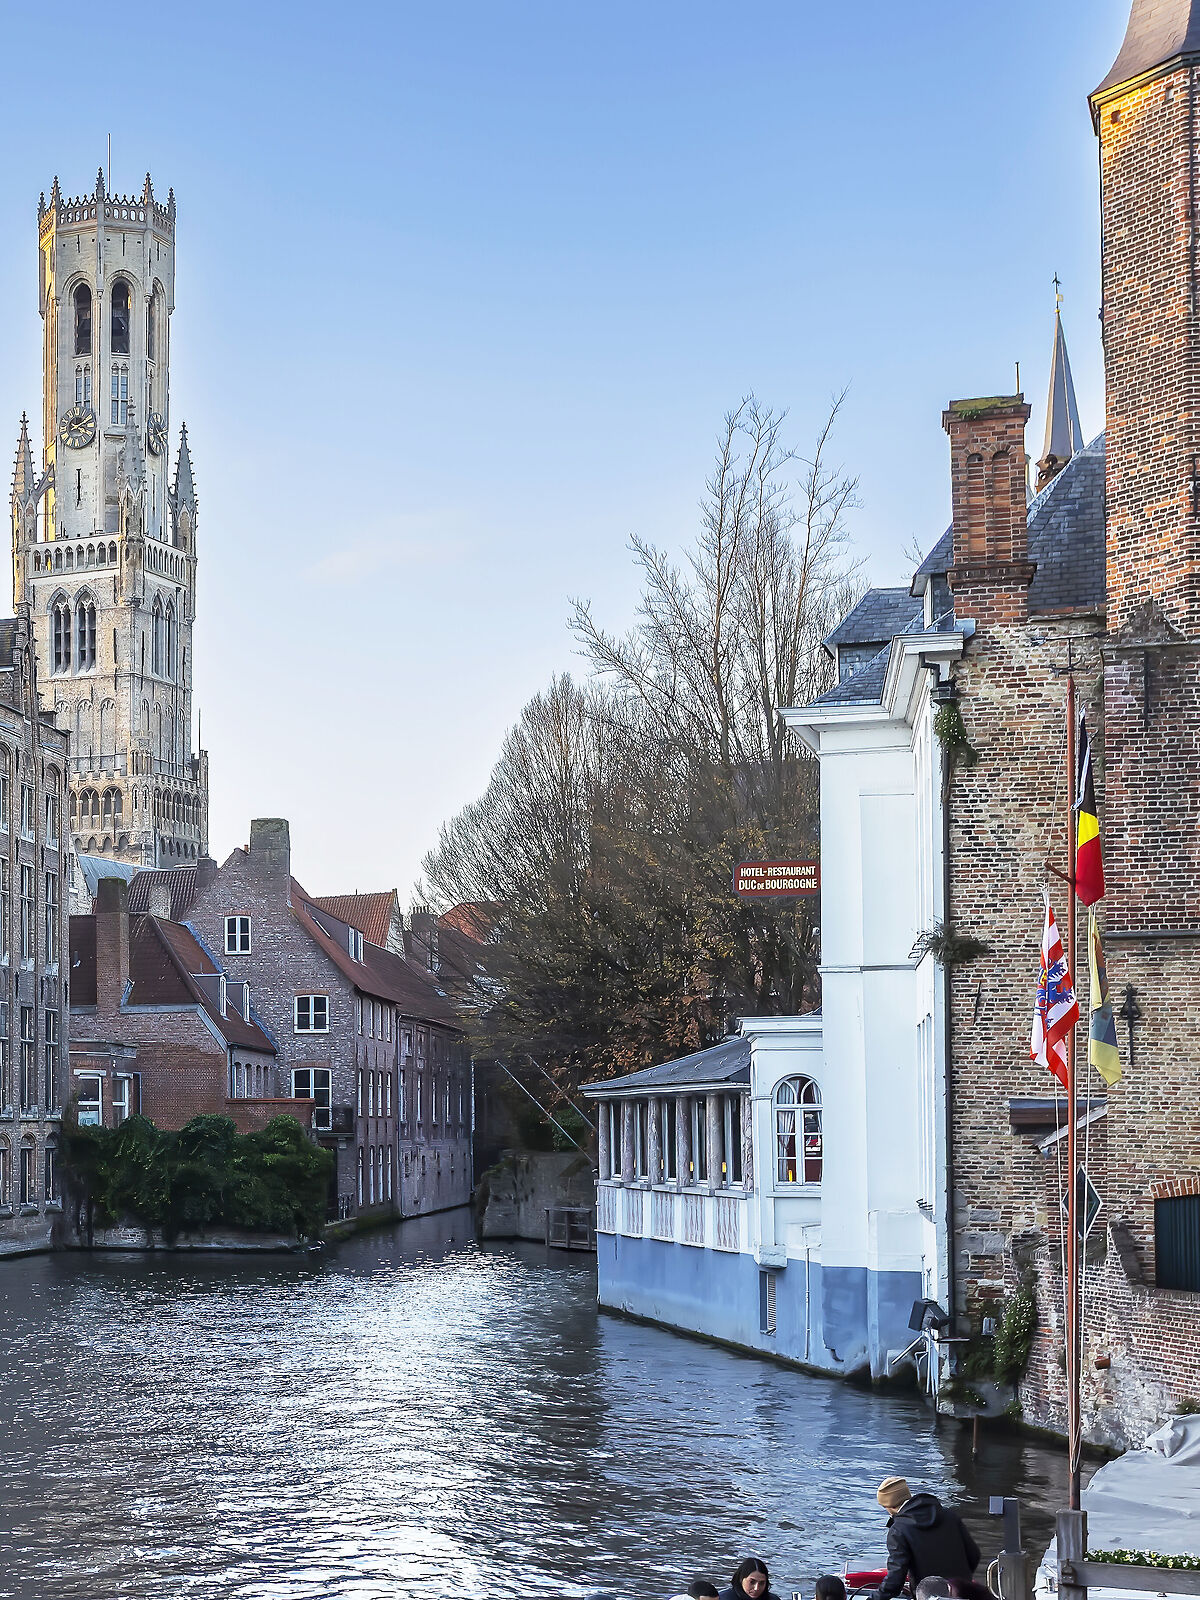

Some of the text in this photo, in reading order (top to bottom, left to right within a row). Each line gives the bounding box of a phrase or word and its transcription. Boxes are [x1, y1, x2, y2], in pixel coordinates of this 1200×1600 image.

[740, 866, 816, 877] HOTEL-RESTAURANT
[738, 879, 756, 891] DUC
[765, 878, 818, 890] BOURGOGNE
